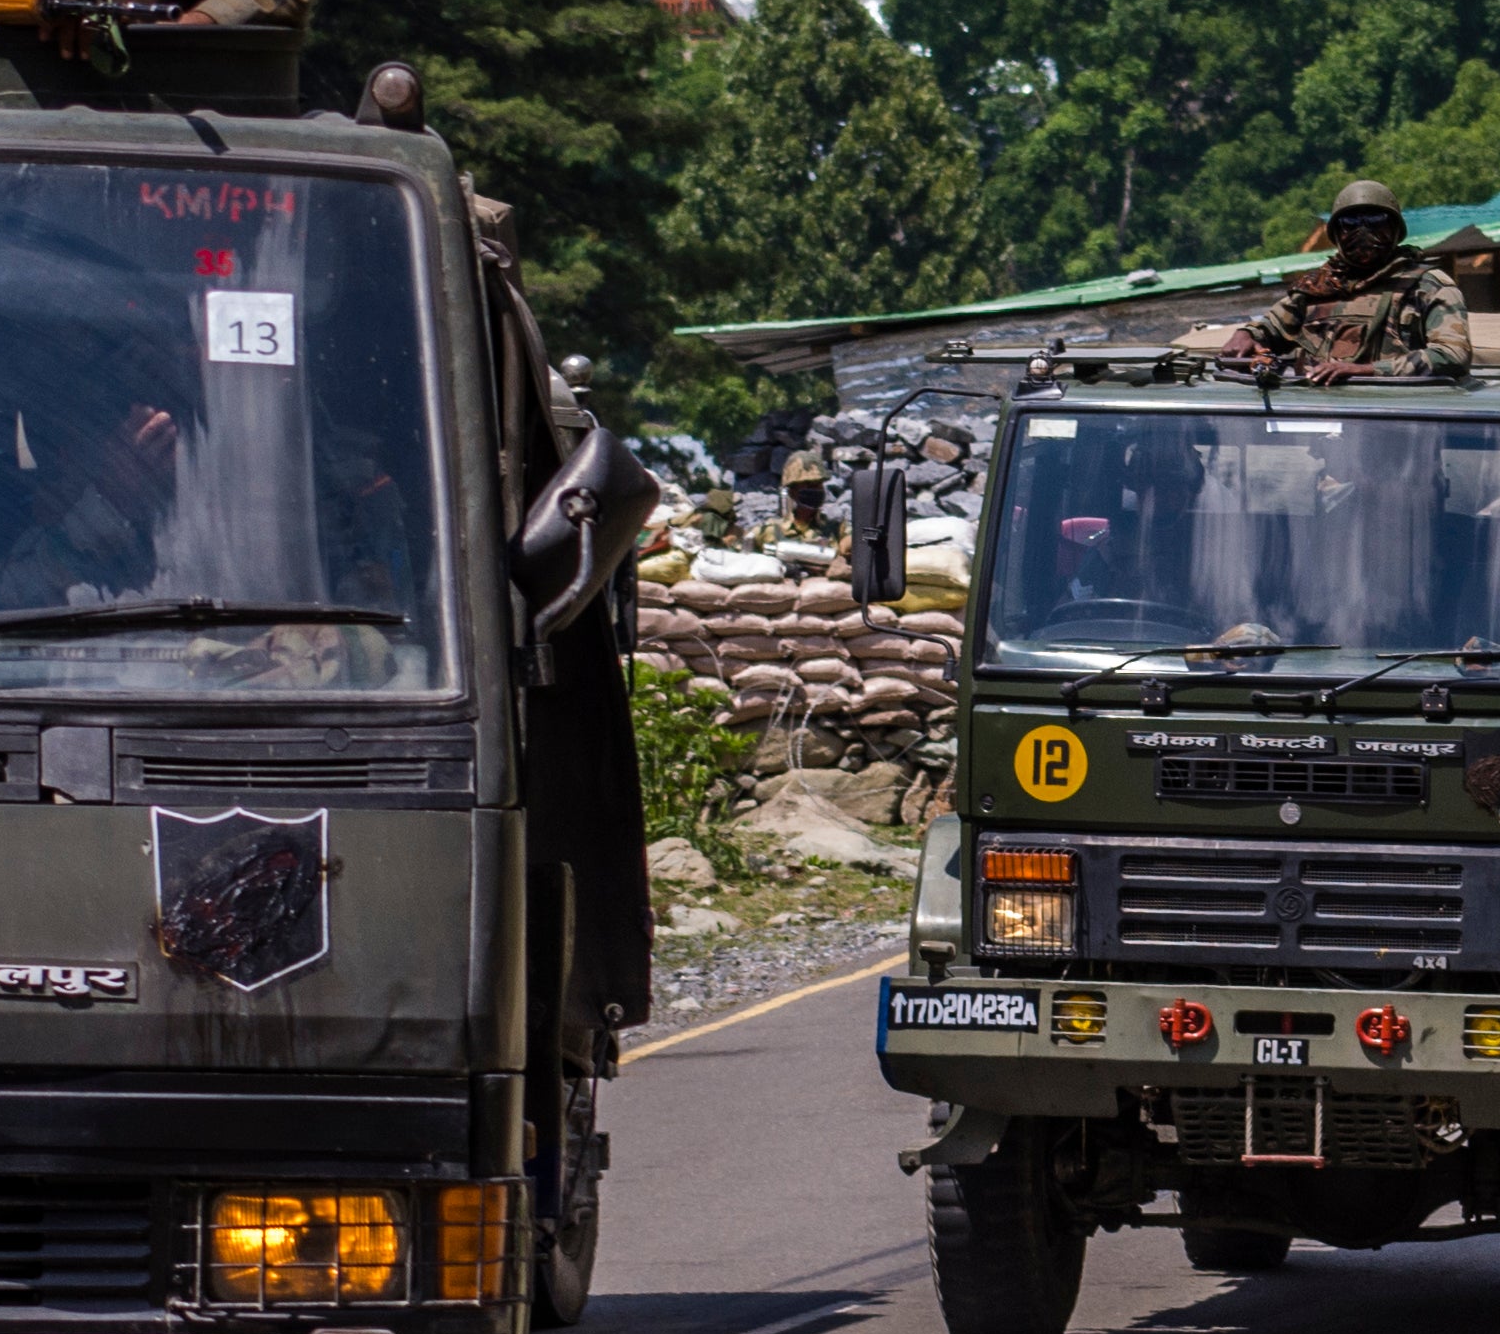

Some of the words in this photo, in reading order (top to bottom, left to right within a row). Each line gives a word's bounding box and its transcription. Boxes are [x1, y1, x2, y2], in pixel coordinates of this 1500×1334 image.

[229, 320, 278, 356] 13
[1133, 734, 1218, 748] व्हीकल
[1240, 734, 1328, 750] फैक्टरी
[1355, 740, 1457, 757] जबलपुर
[1033, 739, 1071, 787] 12
[907, 993, 1038, 1026] 17D204232A
